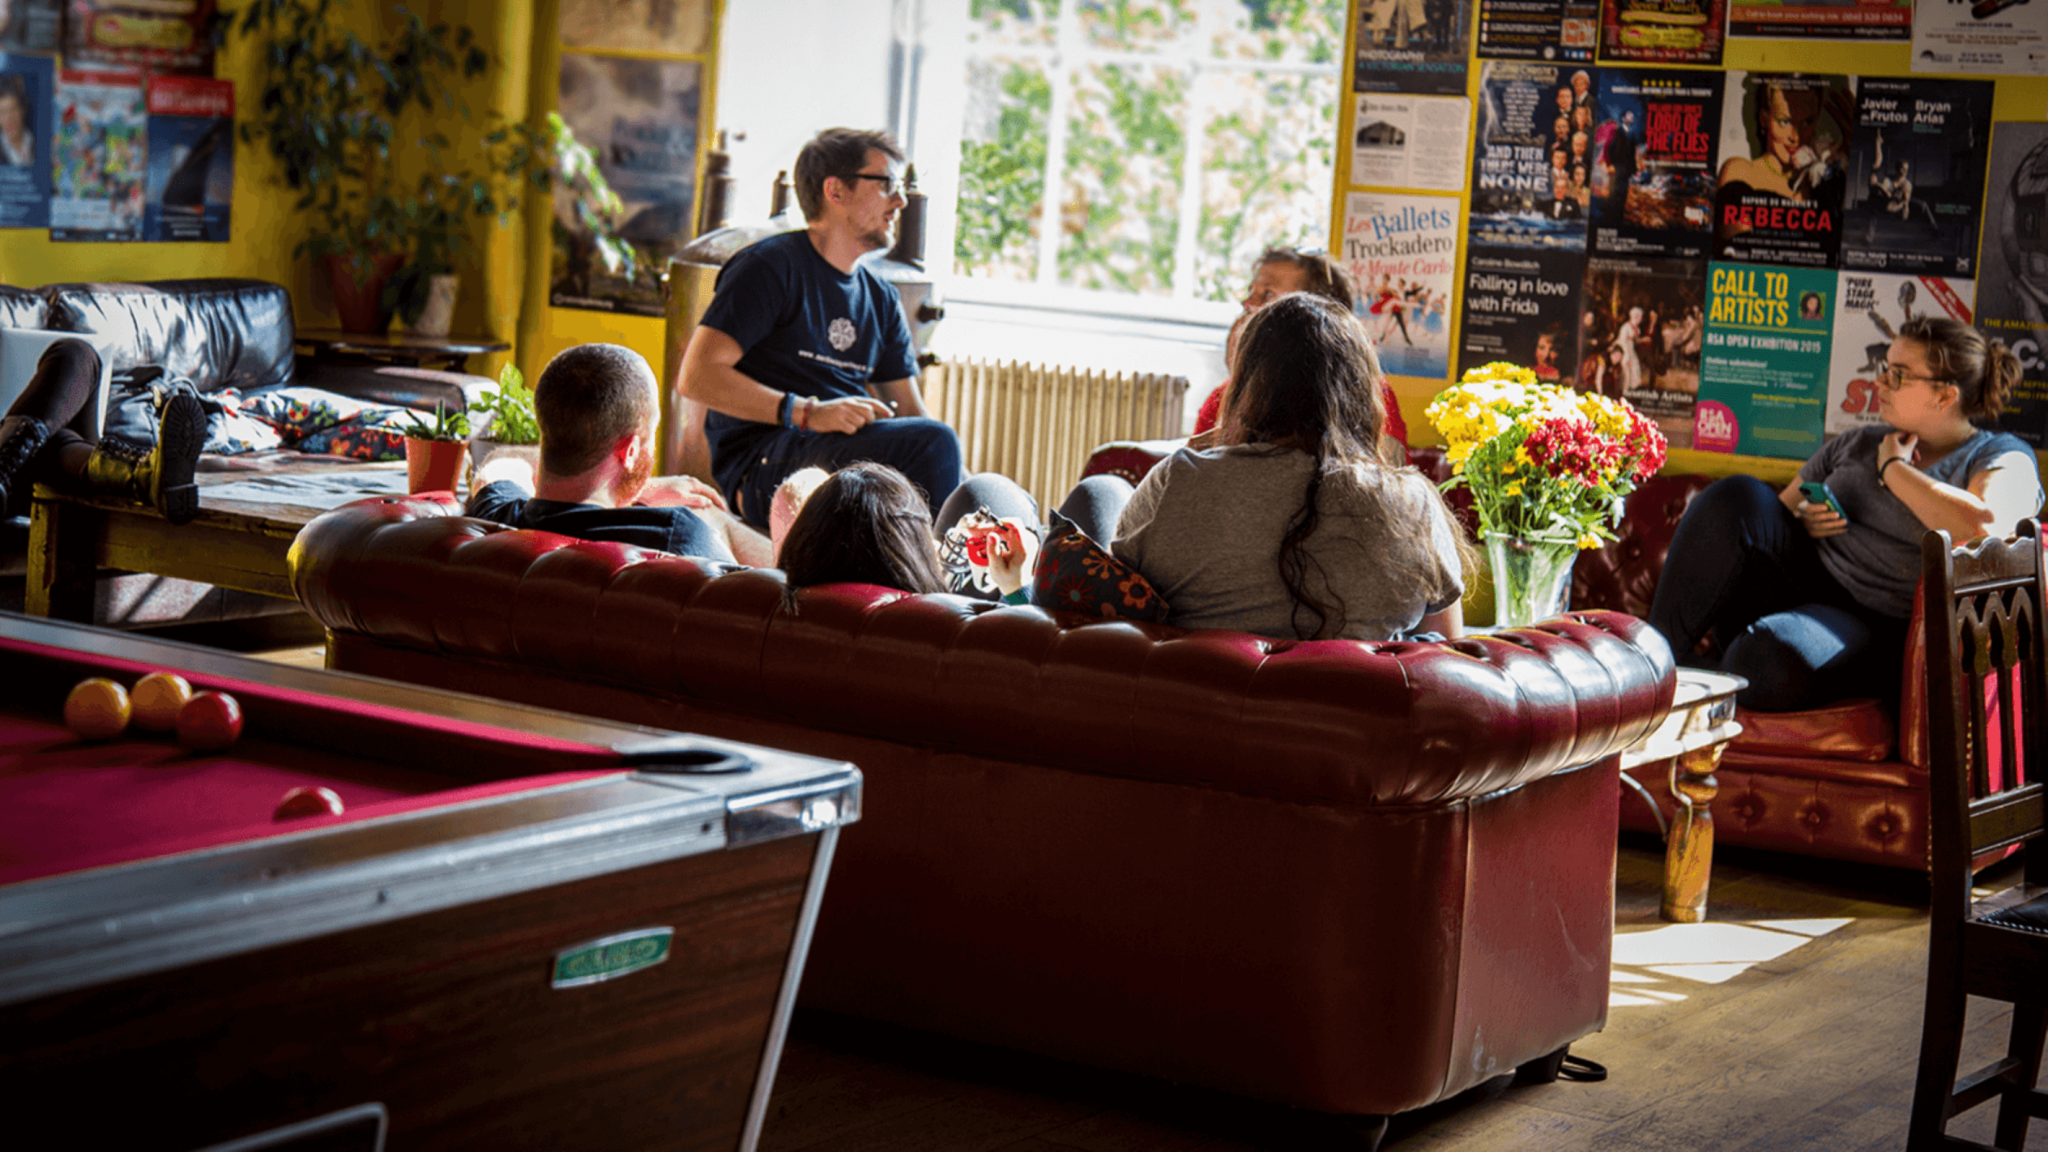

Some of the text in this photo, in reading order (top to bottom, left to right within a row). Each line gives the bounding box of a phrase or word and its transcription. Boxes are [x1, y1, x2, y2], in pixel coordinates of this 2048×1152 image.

[1358, 50, 1425, 61] PHOTOGRAPHY
[1861, 97, 1898, 110] Javier
[1915, 99, 1951, 113] Bryan
[1647, 111, 1702, 133] LORD OF
[1870, 110, 1908, 123] Frutos
[1914, 111, 1945, 124] Arias
[1646, 130, 1709, 153] THE FLIES
[1487, 145, 1545, 161] AND THEN
[1480, 158, 1550, 176] THERE WERE
[1479, 173, 1548, 192] NONE
[1347, 216, 1372, 234] Les
[1371, 206, 1451, 241] Ballets
[1724, 204, 1832, 232] REBECCA
[1346, 233, 1452, 259] Trockadero
[1367, 259, 1410, 276] Monte
[1413, 258, 1451, 275] Carlo
[1469, 272, 1569, 297] Falling in love
[1712, 268, 1789, 299] CALL TO
[1846, 289, 1875, 300] STAGE
[1467, 294, 1540, 316] with Frida
[1709, 295, 1789, 327] ARTISTS
[1984, 318, 2002, 329] THE
[1707, 332, 1821, 354] RSA OPEN EXHIBITION 2015
[1660, 390, 1694, 403] Artists
